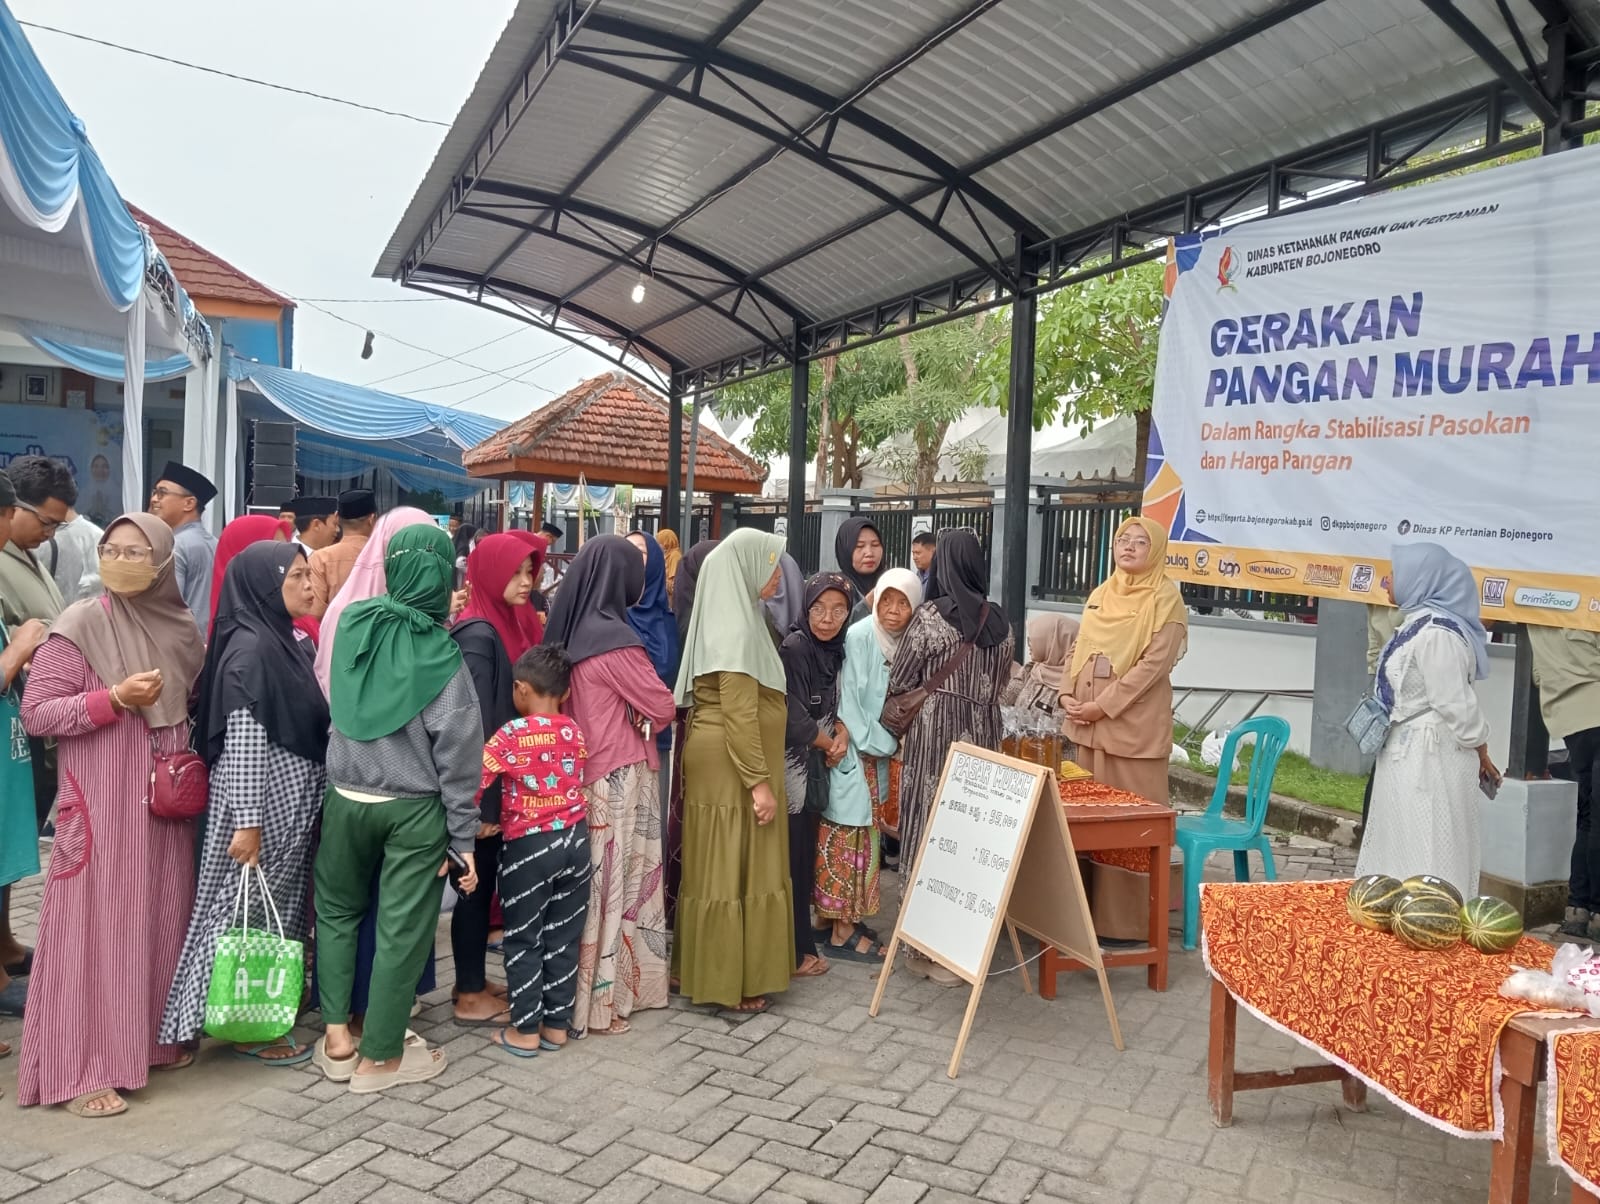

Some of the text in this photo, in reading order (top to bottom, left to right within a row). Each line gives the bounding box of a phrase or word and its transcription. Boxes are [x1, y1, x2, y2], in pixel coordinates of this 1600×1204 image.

[1247, 203, 1500, 263] DINAS KETAHANAN PANGAN DAN PERTANIAN
[1245, 241, 1381, 278] KABUPATEN BOJONEGORO
[1210, 291, 1424, 358] GERAKAN
[1204, 331, 1600, 408] PANGAN MURAH
[1200, 411, 1531, 444] Dalam Rangka Stabilisasi Pasokan
[1200, 450, 1353, 475] dan Harga Pangan
[1332, 520, 1388, 533] dkppbojonegoro
[1412, 524, 1553, 542] Dinas KP Pertanian Bojonegoro
[1249, 563, 1291, 577] INDOMARCO
[954, 753, 992, 786] PASAR
[993, 765, 1034, 799] MURAH
[522, 794, 567, 808] THOMAS
[234, 967, 287, 999] A-U
